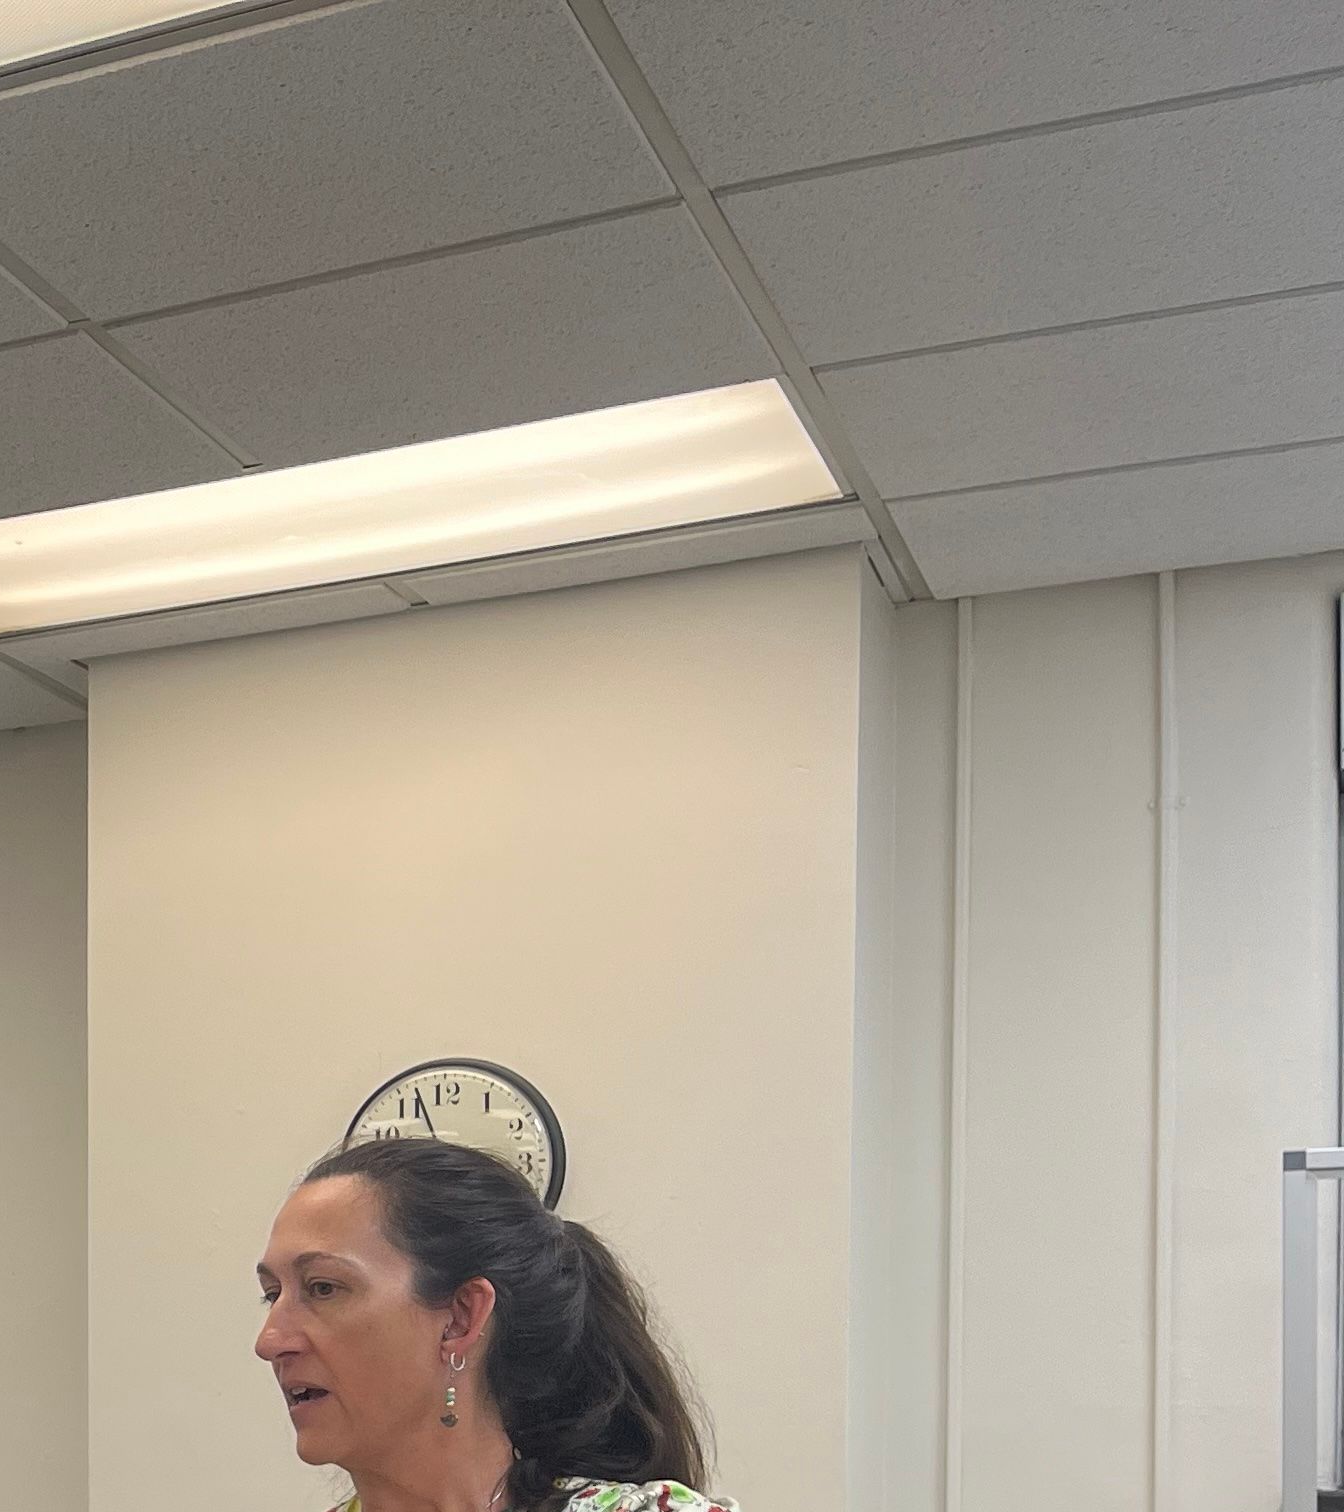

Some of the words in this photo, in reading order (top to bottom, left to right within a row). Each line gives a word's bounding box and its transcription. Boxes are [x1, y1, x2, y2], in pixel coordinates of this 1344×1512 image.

[434, 1082, 460, 1106] 12
[483, 1091, 491, 1113] 1
[397, 1097, 422, 1119] 11
[509, 1118, 523, 1140] 2
[518, 1152, 533, 1175] 3
